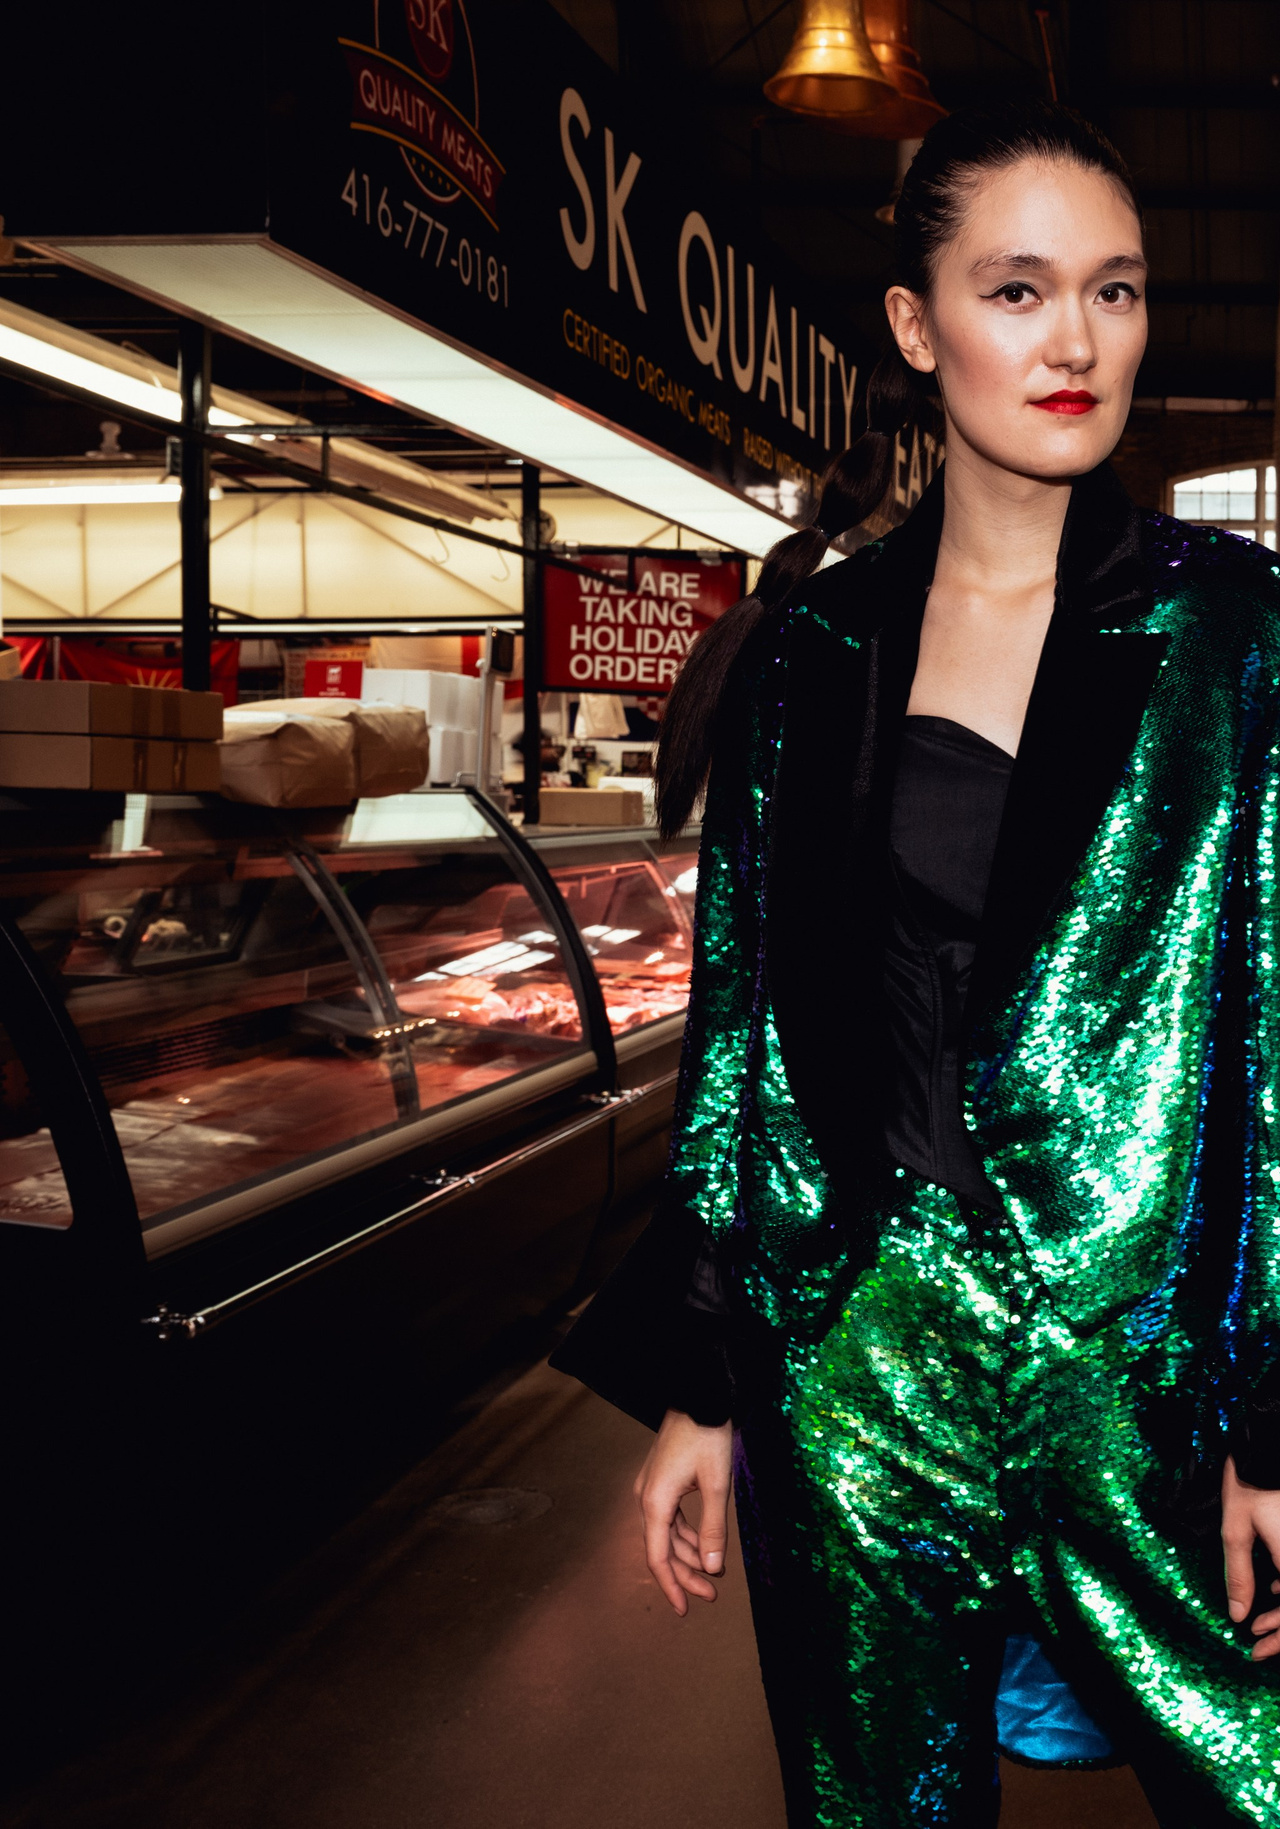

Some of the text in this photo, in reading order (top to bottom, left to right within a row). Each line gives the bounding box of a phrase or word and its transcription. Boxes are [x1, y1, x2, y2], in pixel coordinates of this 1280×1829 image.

[359, 69, 494, 200] QUALITY MEATS
[340, 167, 509, 309] 416-777-0181
[558, 87, 946, 510] SK QUALITY EAT
[562, 307, 632, 381] CERTIFIED
[635, 354, 696, 425] ORGANIC
[697, 398, 732, 447] MEATS
[577, 569, 701, 599] WE ARE
[577, 595, 694, 629] TAKING
[568, 652, 684, 685] ORDER
[569, 623, 701, 656] HOLIDAY
